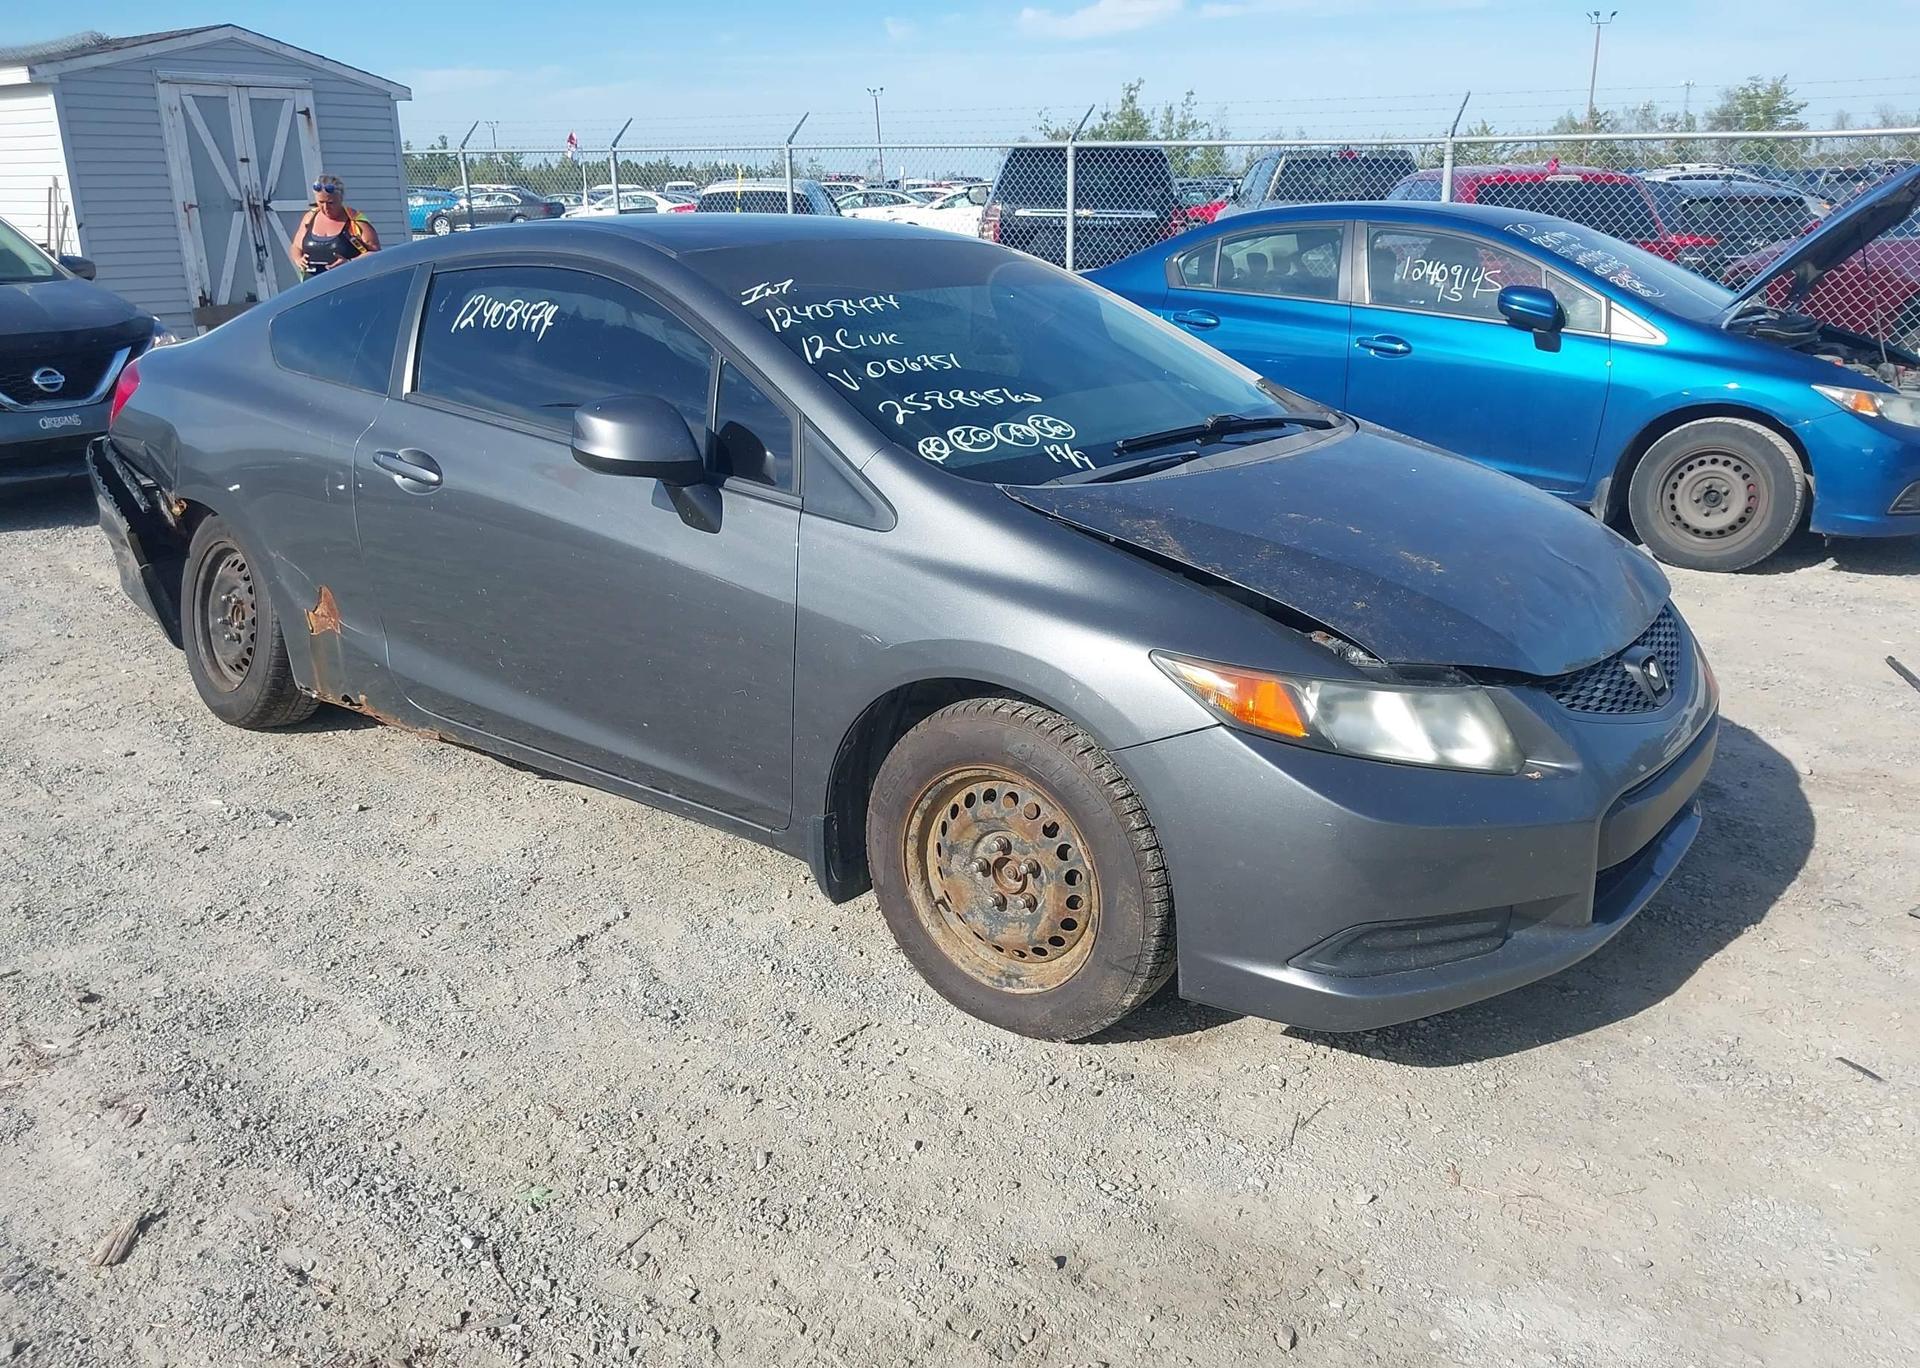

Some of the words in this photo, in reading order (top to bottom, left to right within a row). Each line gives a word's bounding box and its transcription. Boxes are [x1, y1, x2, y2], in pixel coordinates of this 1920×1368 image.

[1402, 256, 1502, 299] 12409145
[451, 294, 559, 343] 12408474
[766, 294, 901, 333] 12408474
